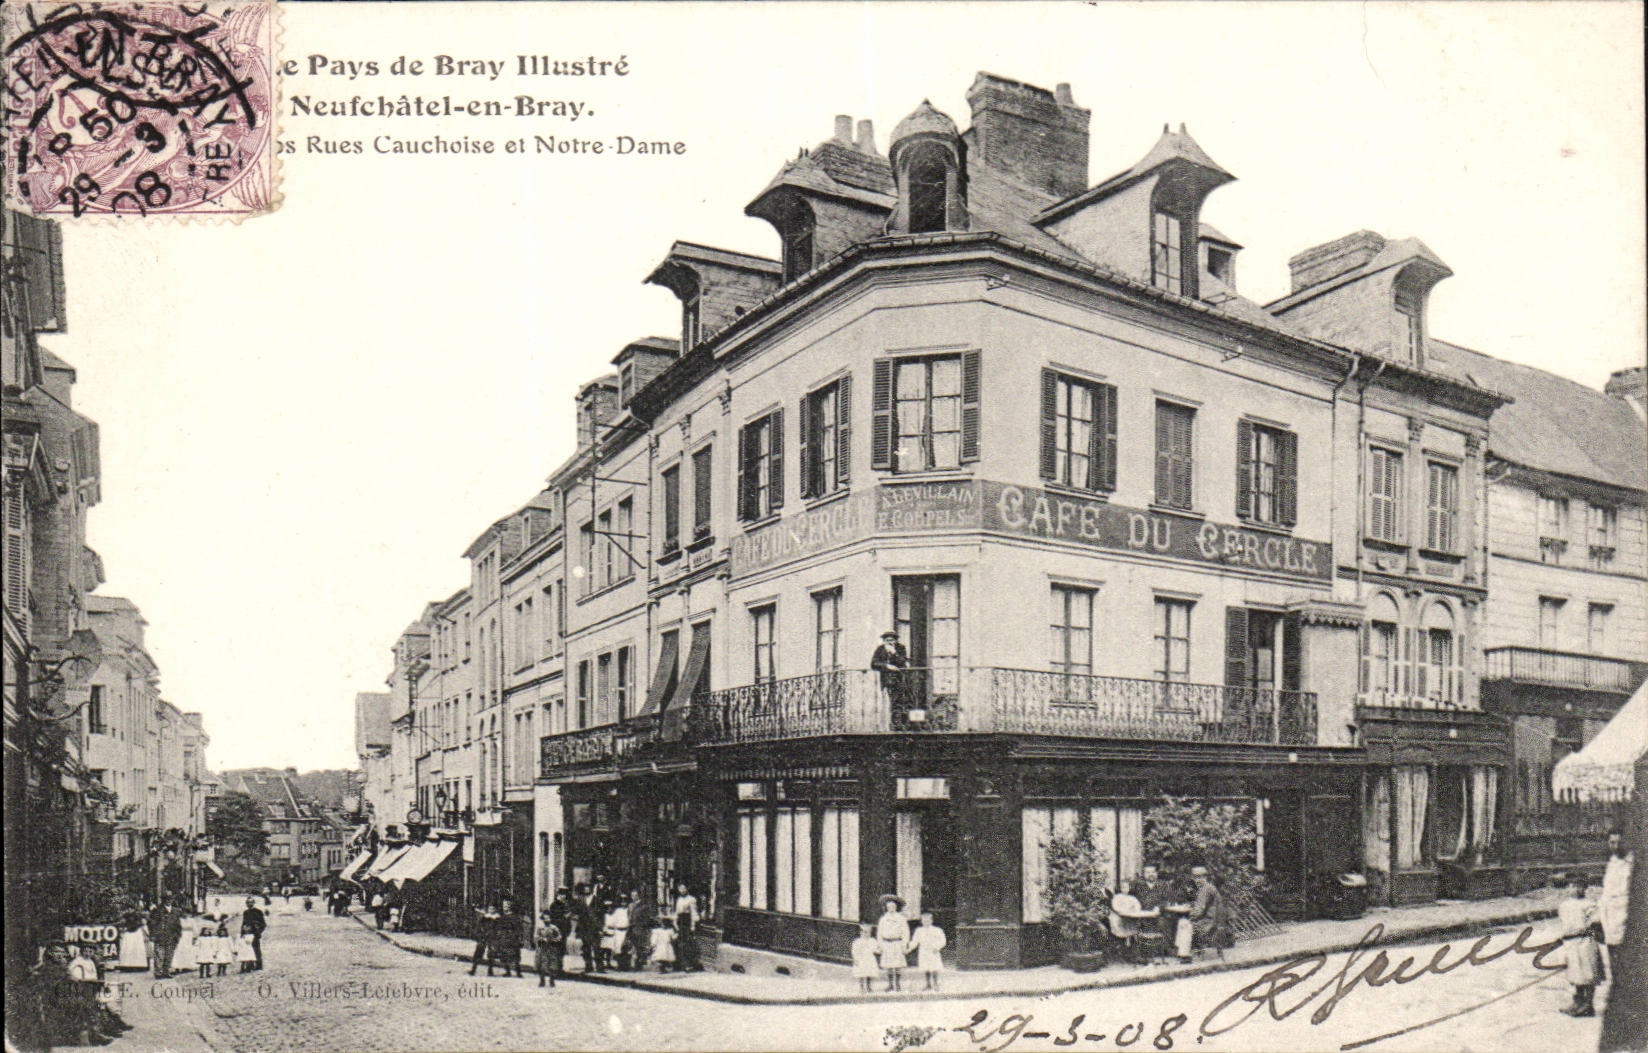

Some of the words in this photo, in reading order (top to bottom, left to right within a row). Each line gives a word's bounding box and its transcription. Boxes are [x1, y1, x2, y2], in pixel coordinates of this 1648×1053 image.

[1126, 512, 1172, 551] DU
[1195, 523, 1319, 577] CERCLE
[64, 925, 119, 943] MOTO
